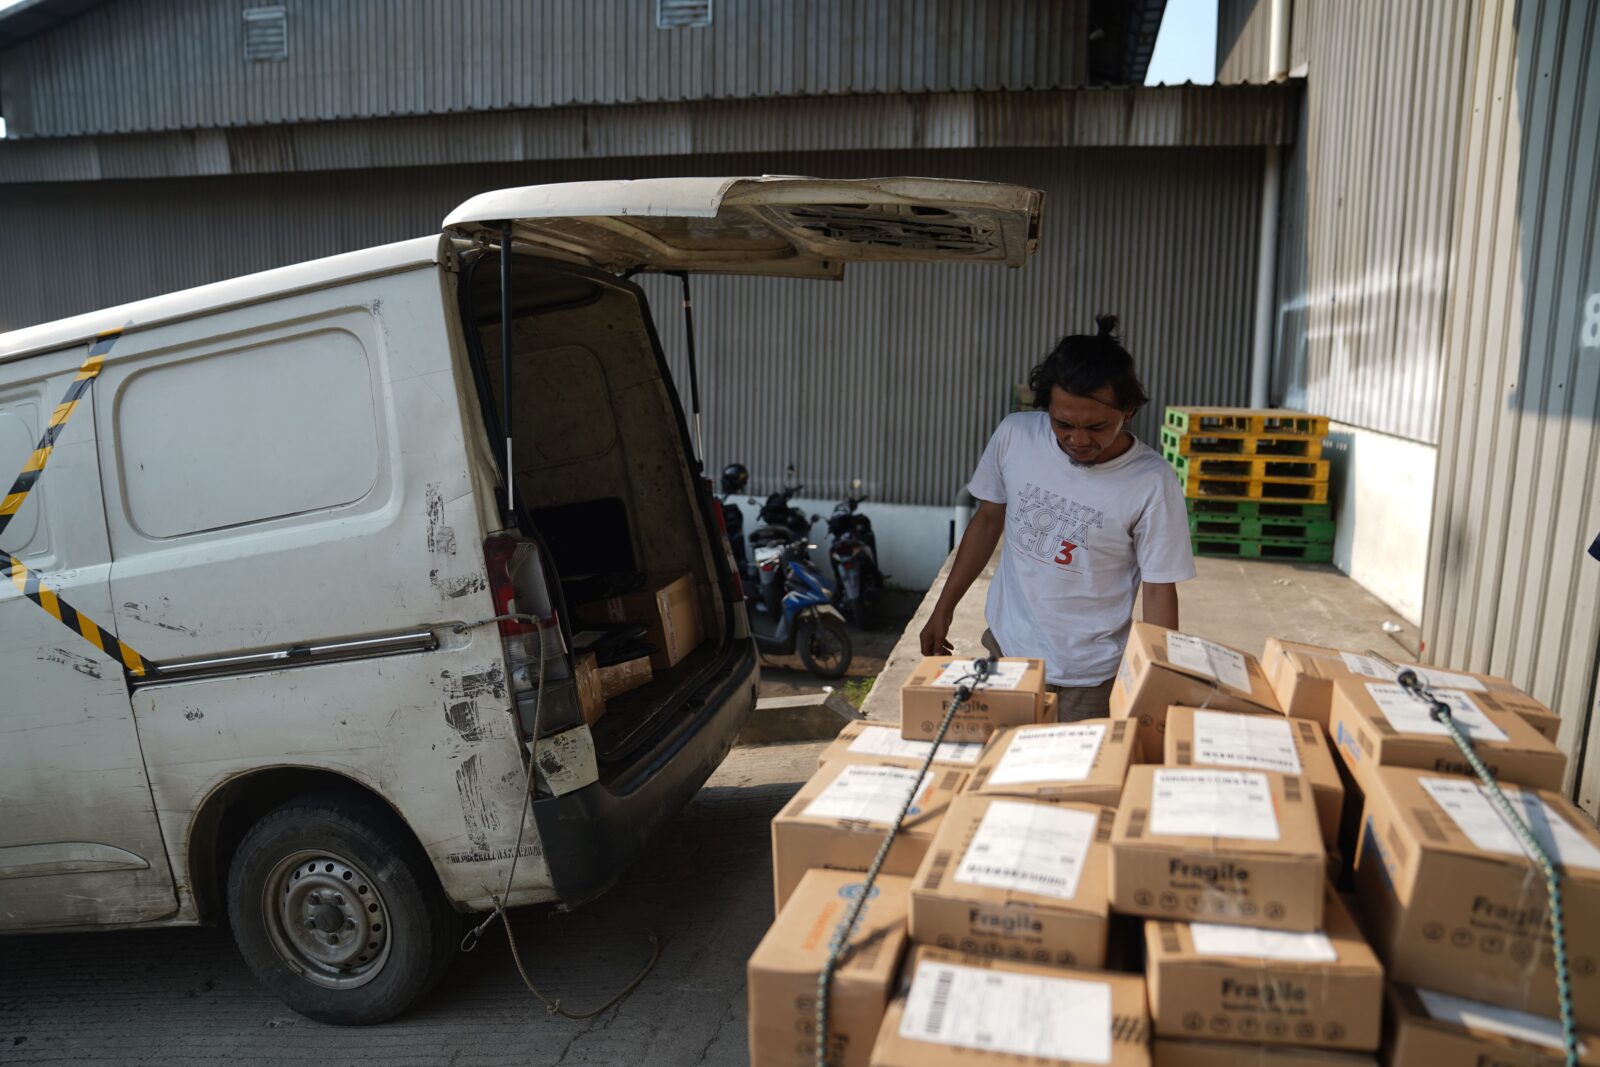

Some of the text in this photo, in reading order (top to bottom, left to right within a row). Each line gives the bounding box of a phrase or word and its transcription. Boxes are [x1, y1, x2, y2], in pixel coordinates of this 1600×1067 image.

[1018, 482, 1104, 529] JAKARTA
[1015, 498, 1088, 551] KOTA
[942, 700, 988, 713] Fagile
[1169, 857, 1248, 881] Fragile
[969, 908, 1043, 932] Fragile
[1221, 977, 1306, 1002] Fragile
